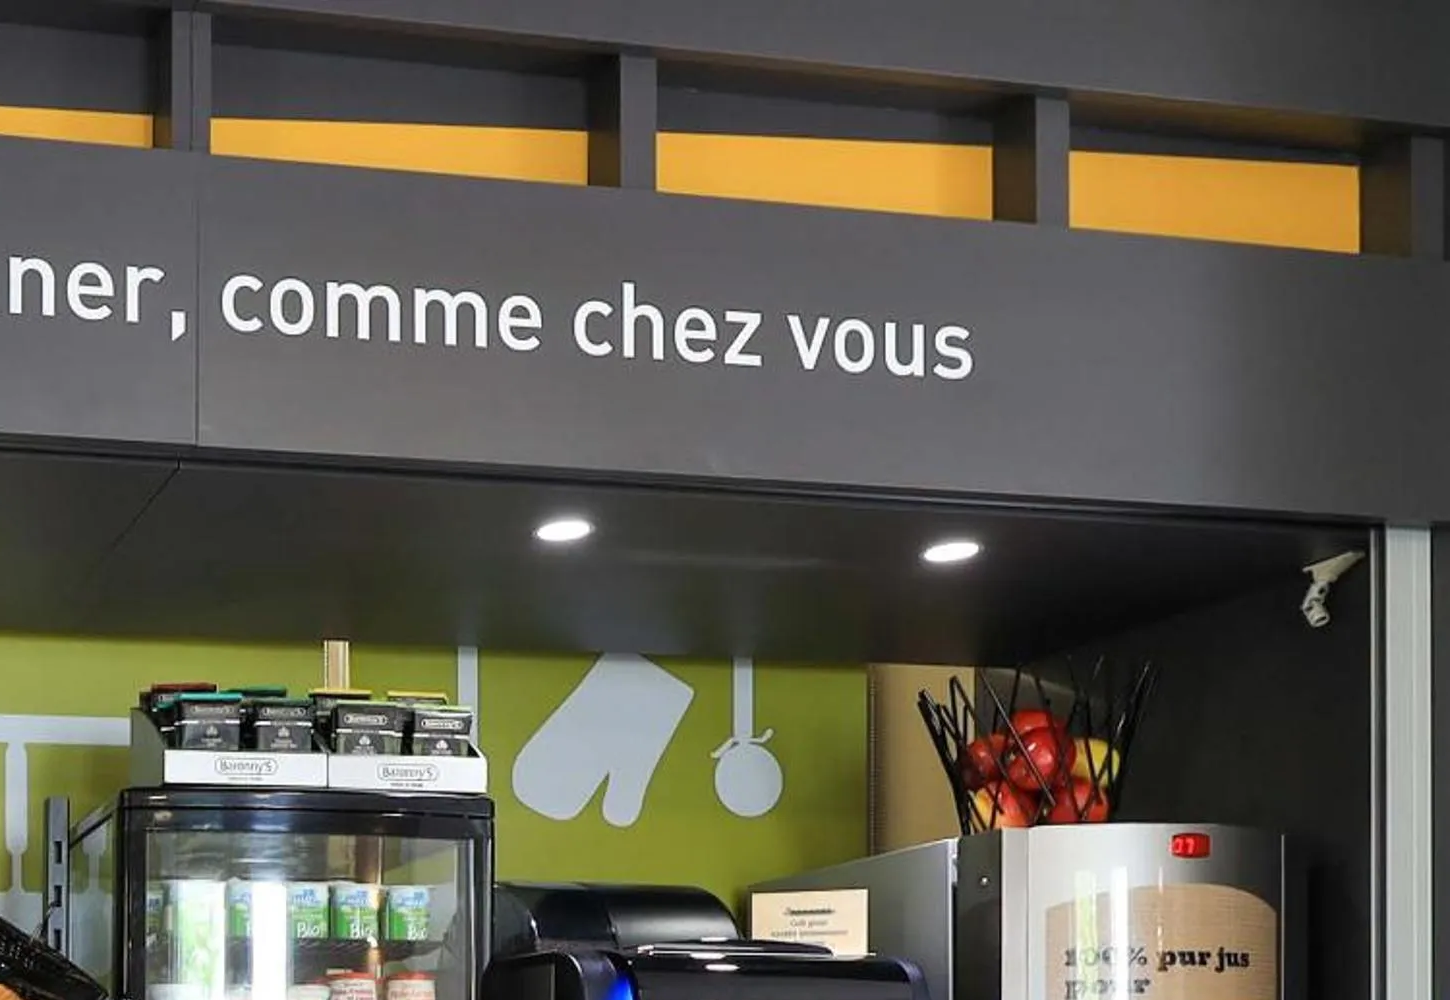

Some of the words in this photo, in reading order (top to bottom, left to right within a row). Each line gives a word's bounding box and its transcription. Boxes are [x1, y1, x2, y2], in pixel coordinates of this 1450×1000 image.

[221, 274, 543, 351] comme
[573, 282, 762, 367] chez
[786, 314, 973, 380] vous
[1157, 949, 1212, 972] pur
[1214, 946, 1250, 973] jus
